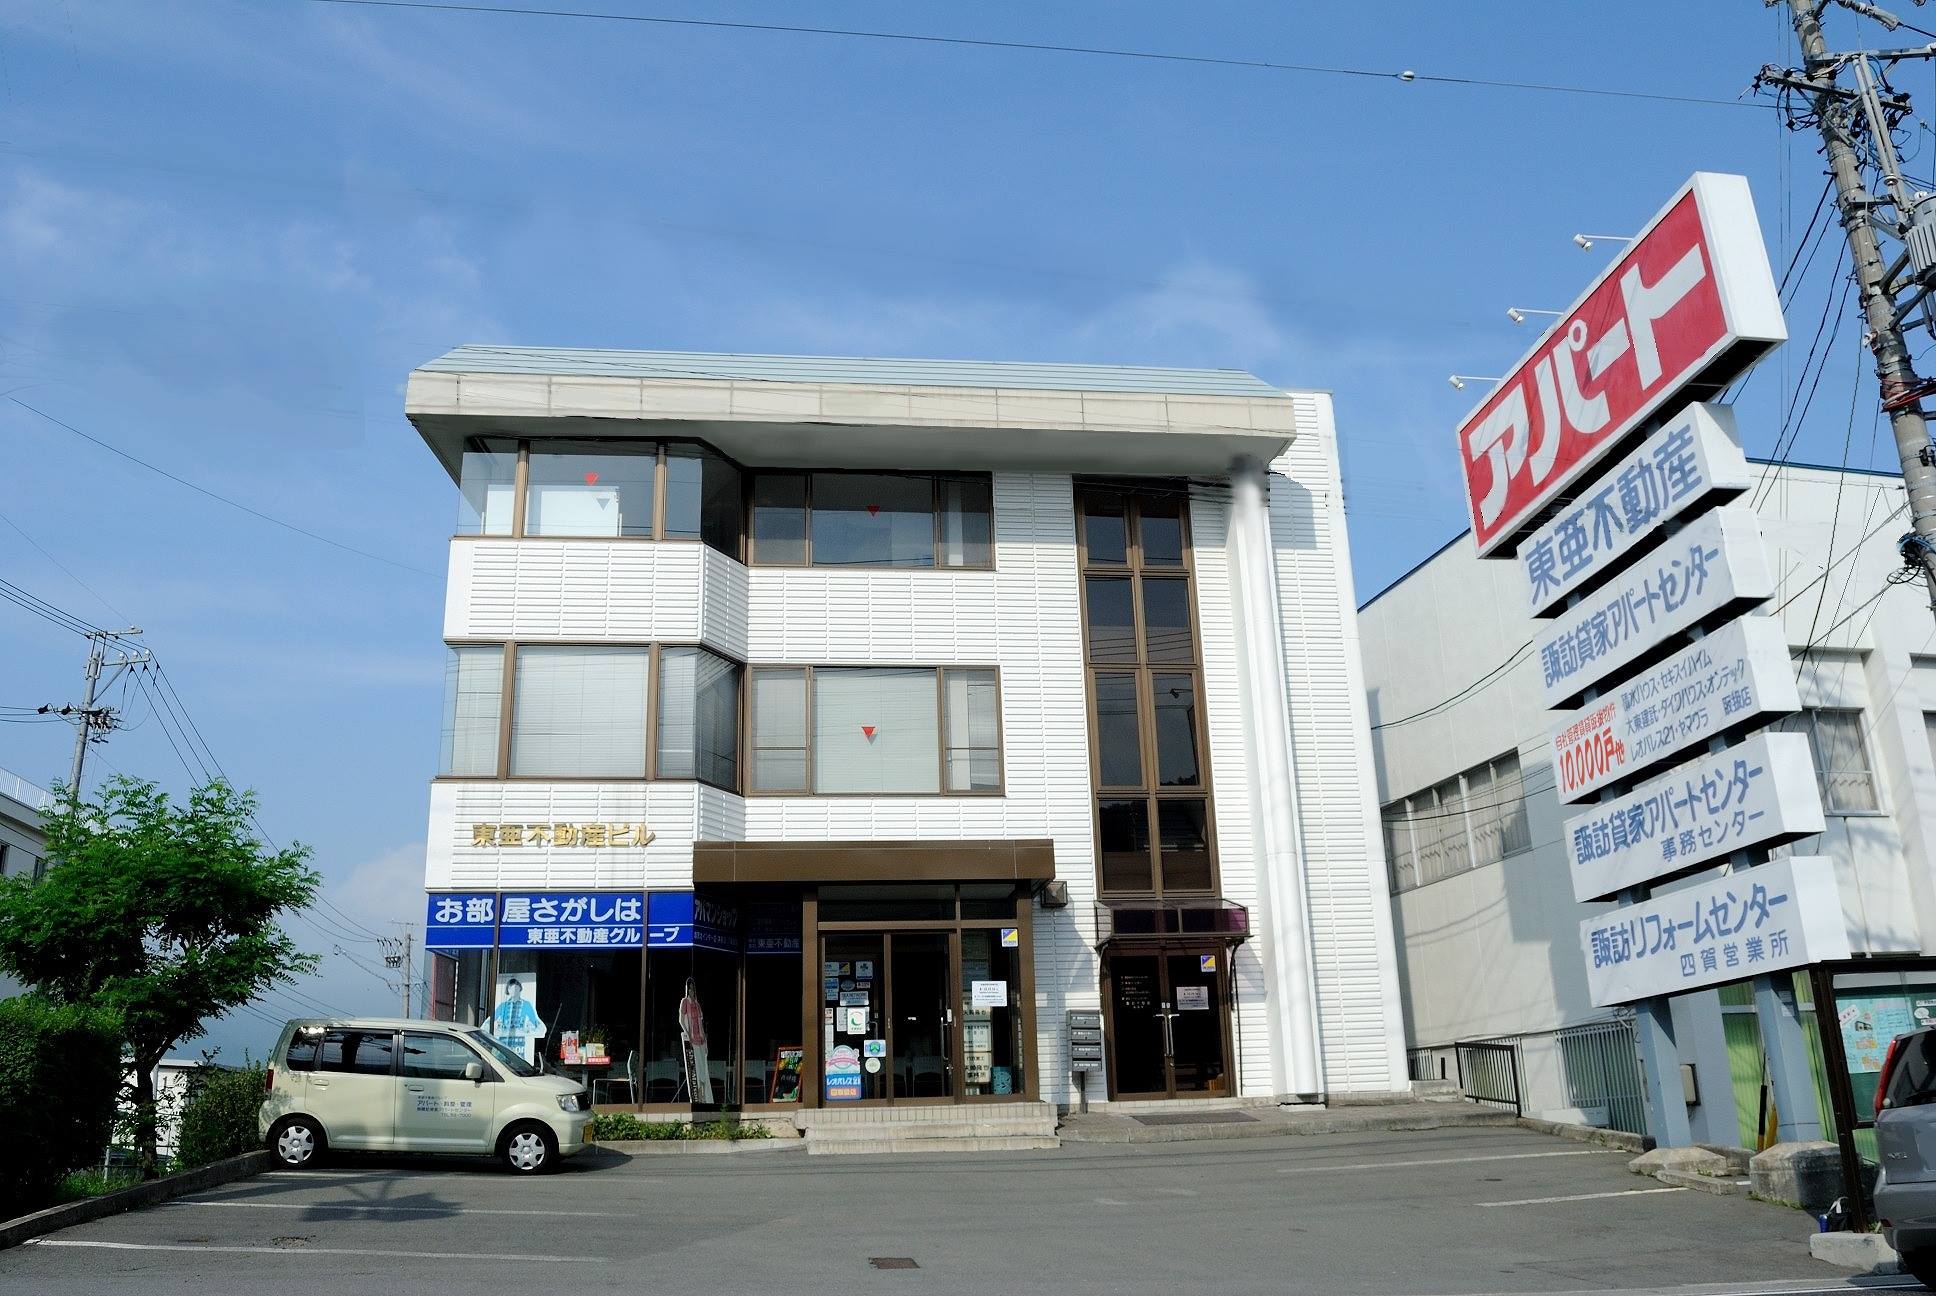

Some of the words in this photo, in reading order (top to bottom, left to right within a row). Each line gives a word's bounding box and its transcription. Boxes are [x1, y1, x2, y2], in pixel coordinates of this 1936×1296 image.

[1468, 243, 1707, 532] アパート
[1525, 423, 1703, 605] 東亜不動産
[1541, 544, 1720, 689] 諏訪貸家アパートセンター
[471, 823, 656, 848] 東亜不動産ビル
[1573, 758, 1764, 866] 諏訪貸家アパートセンター
[1660, 808, 1765, 864] 事務センター
[1591, 882, 1789, 970] 諏訪リフォームセンター
[1679, 931, 1790, 979] 四賀営業所
